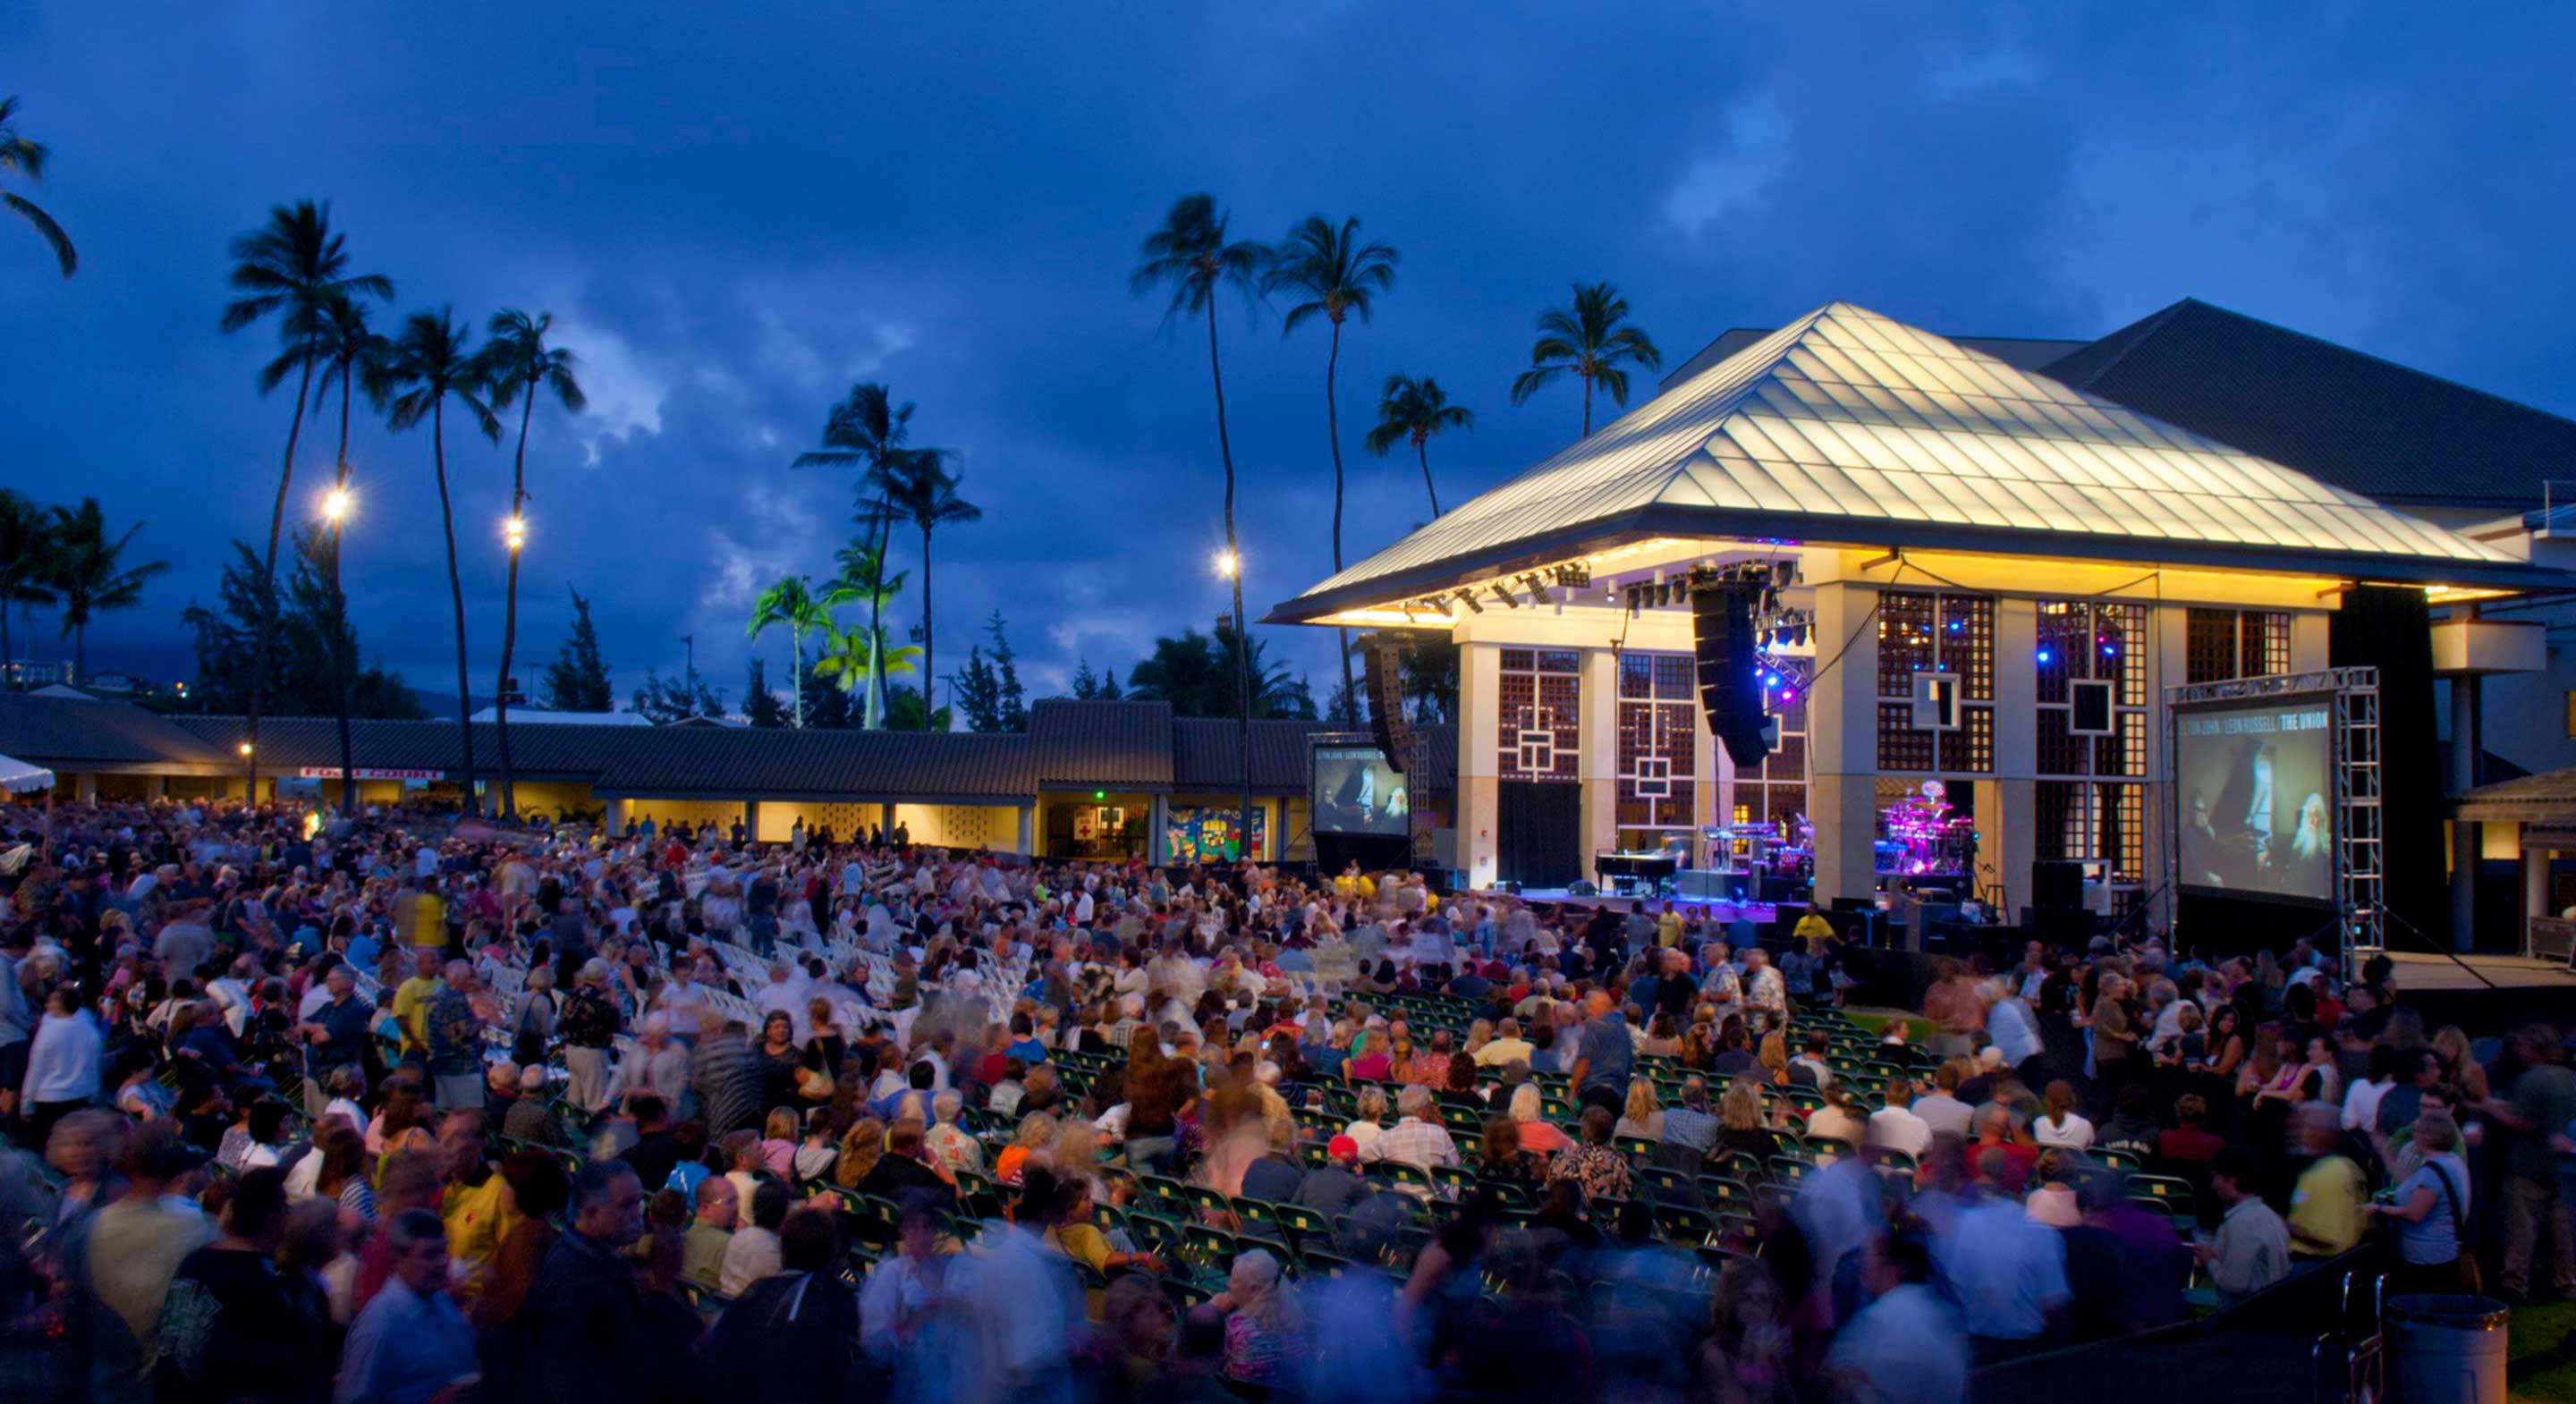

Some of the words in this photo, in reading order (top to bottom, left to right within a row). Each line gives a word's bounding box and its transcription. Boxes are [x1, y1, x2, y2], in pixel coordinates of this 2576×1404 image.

[2280, 714, 2298, 730] THE
[2299, 711, 2327, 729] UNION
[369, 768, 439, 779] COURT
